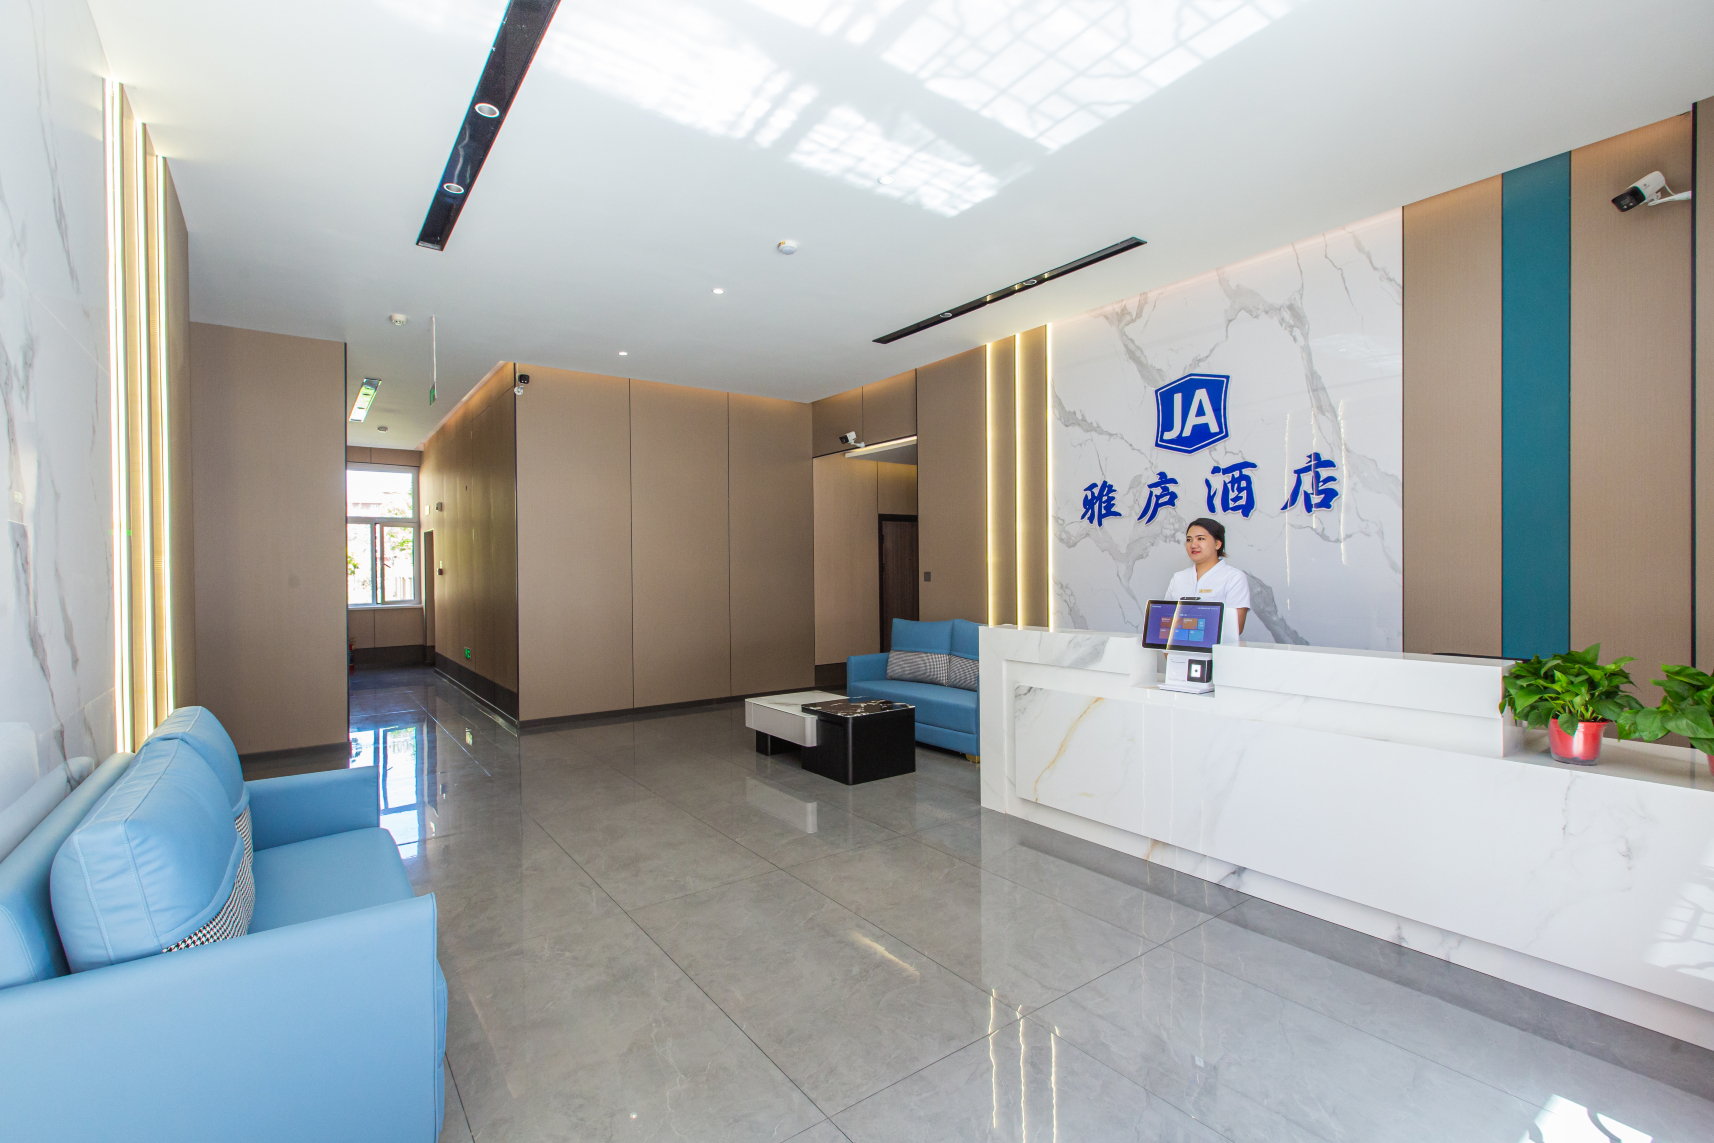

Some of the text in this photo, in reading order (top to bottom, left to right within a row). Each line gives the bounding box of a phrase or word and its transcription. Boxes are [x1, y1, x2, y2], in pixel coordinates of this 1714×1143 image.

[1163, 388, 1220, 440] JA
[1080, 452, 1340, 527] 雅庐酒店
